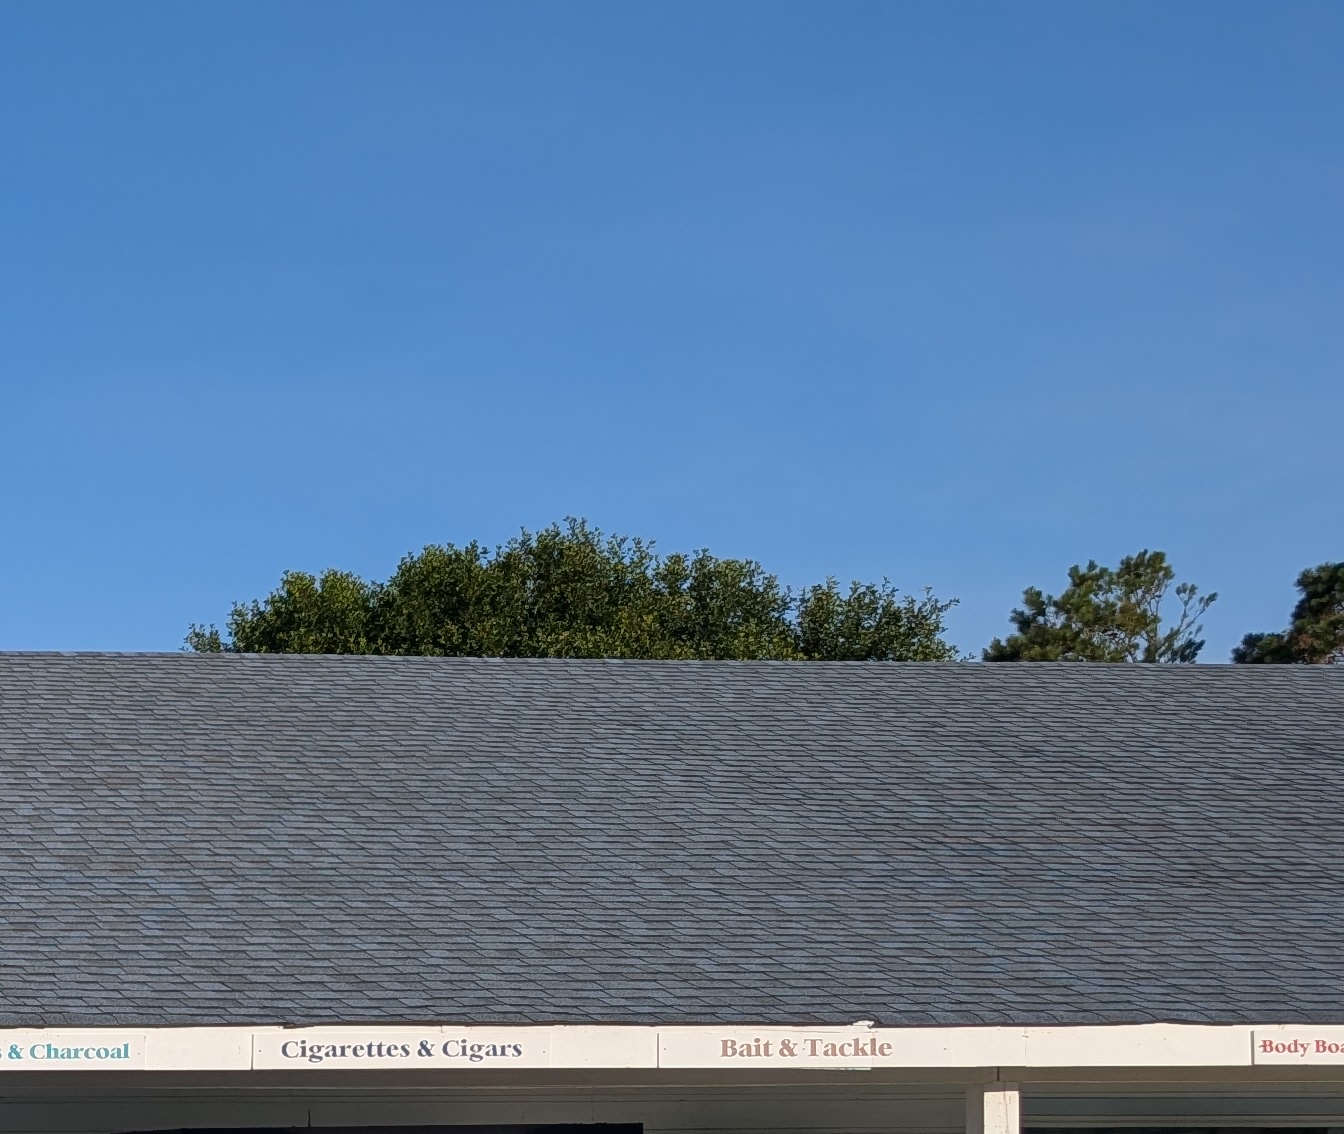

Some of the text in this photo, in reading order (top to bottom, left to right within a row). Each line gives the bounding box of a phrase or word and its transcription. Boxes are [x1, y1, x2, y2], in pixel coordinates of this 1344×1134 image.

[8, 1044, 24, 1060] &
[29, 1043, 130, 1060] Charcoal
[281, 1039, 523, 1063] Cigarettes & Cigars
[720, 1037, 893, 1057] Bait & Tackle
[1259, 1039, 1310, 1057] Body
